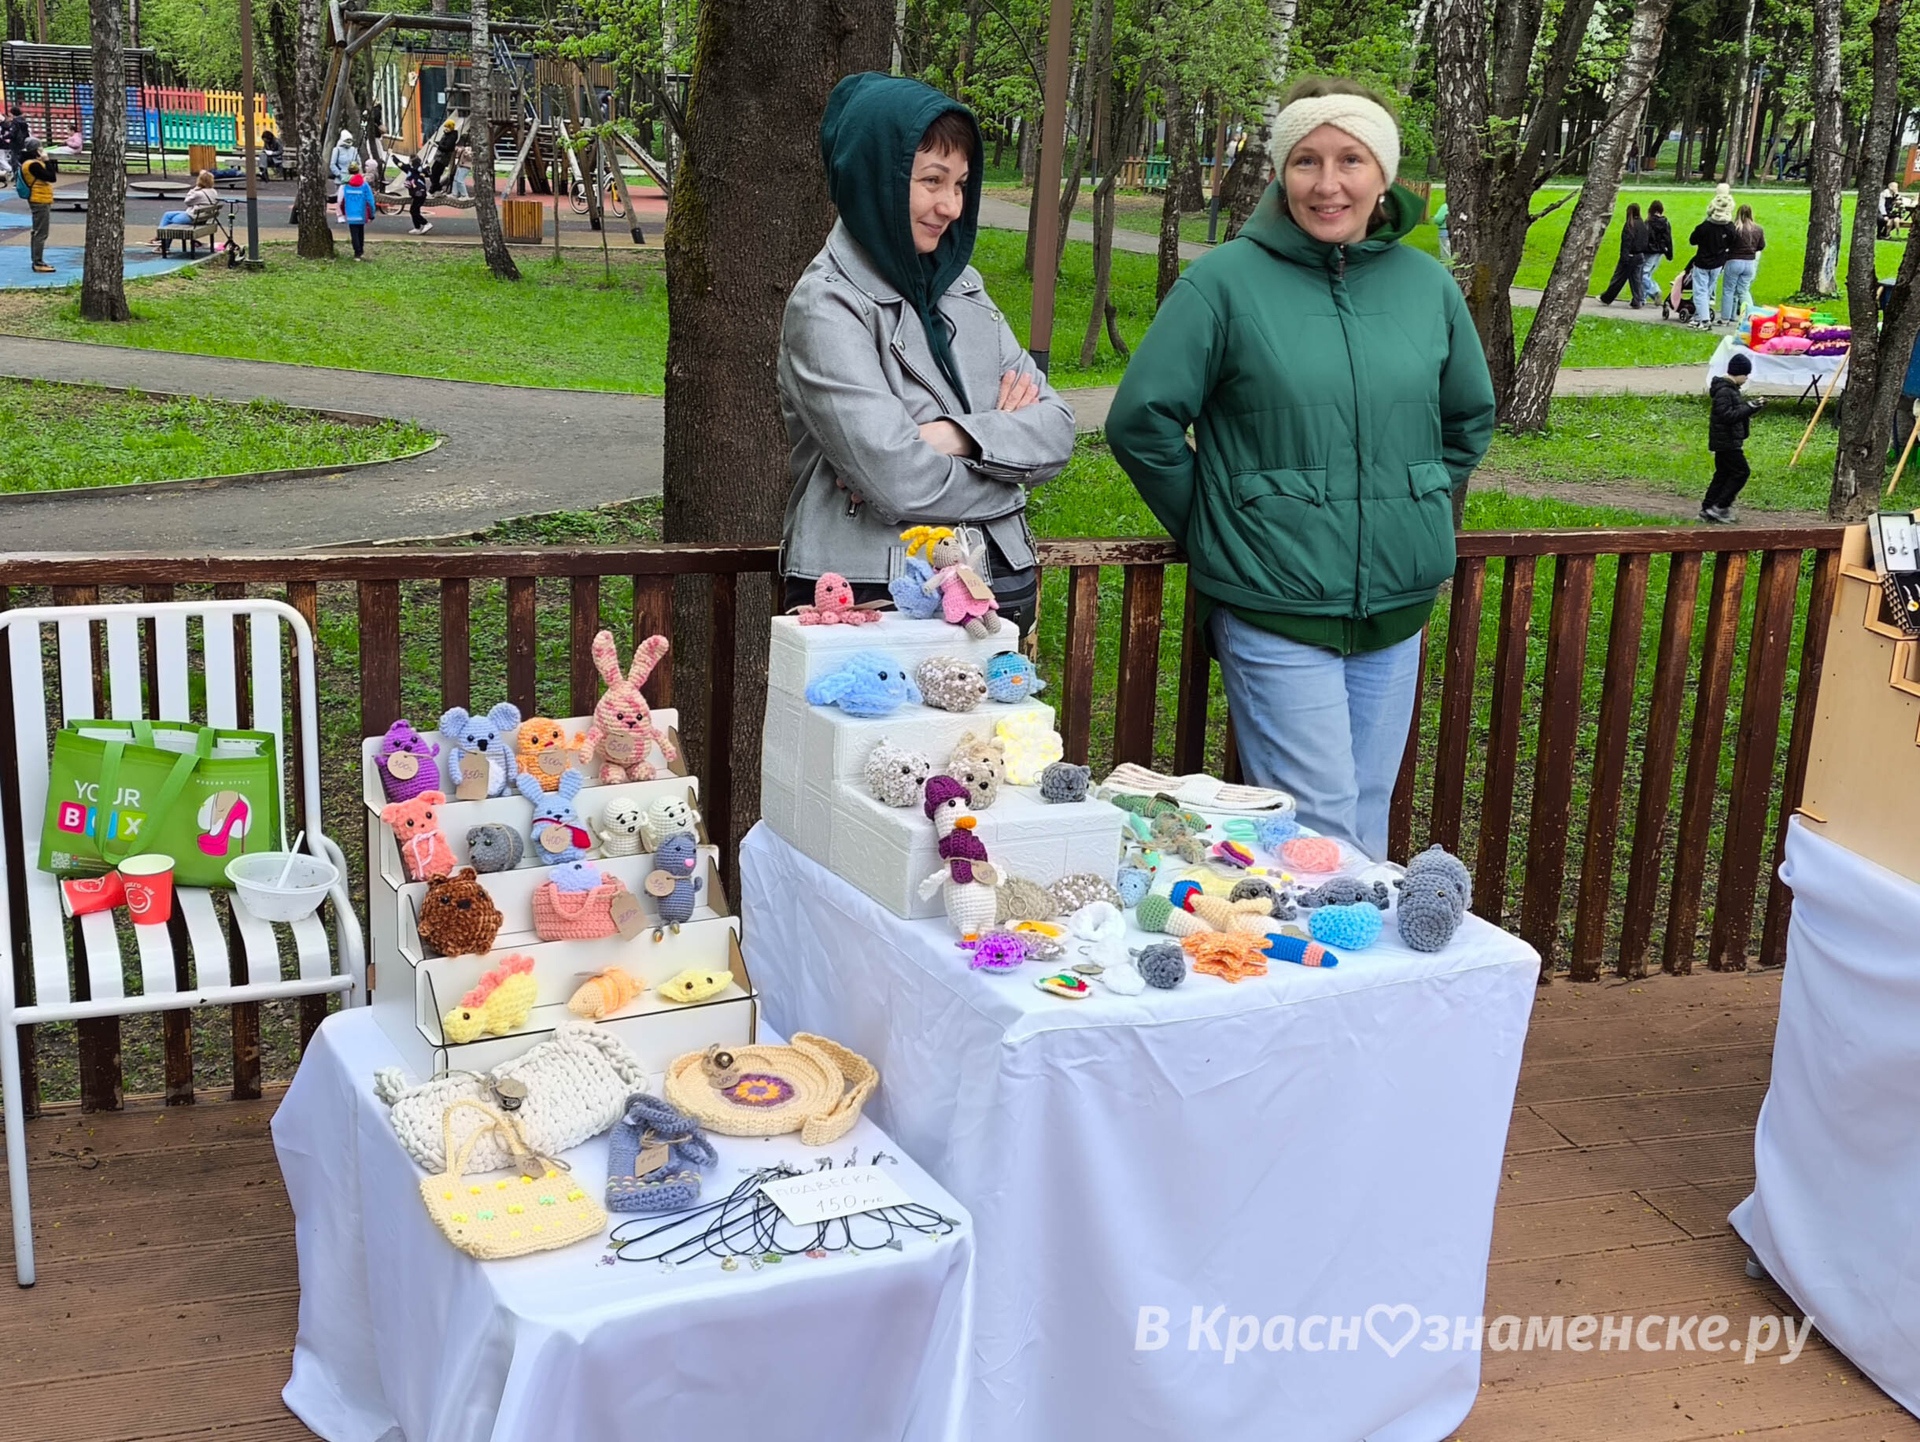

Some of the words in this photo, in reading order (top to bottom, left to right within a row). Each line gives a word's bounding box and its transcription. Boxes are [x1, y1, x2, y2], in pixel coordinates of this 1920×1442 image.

[64, 807, 143, 836] BX
[775, 1173, 878, 1198] ПОДВЕСКА
[816, 1194, 857, 1213] 150
